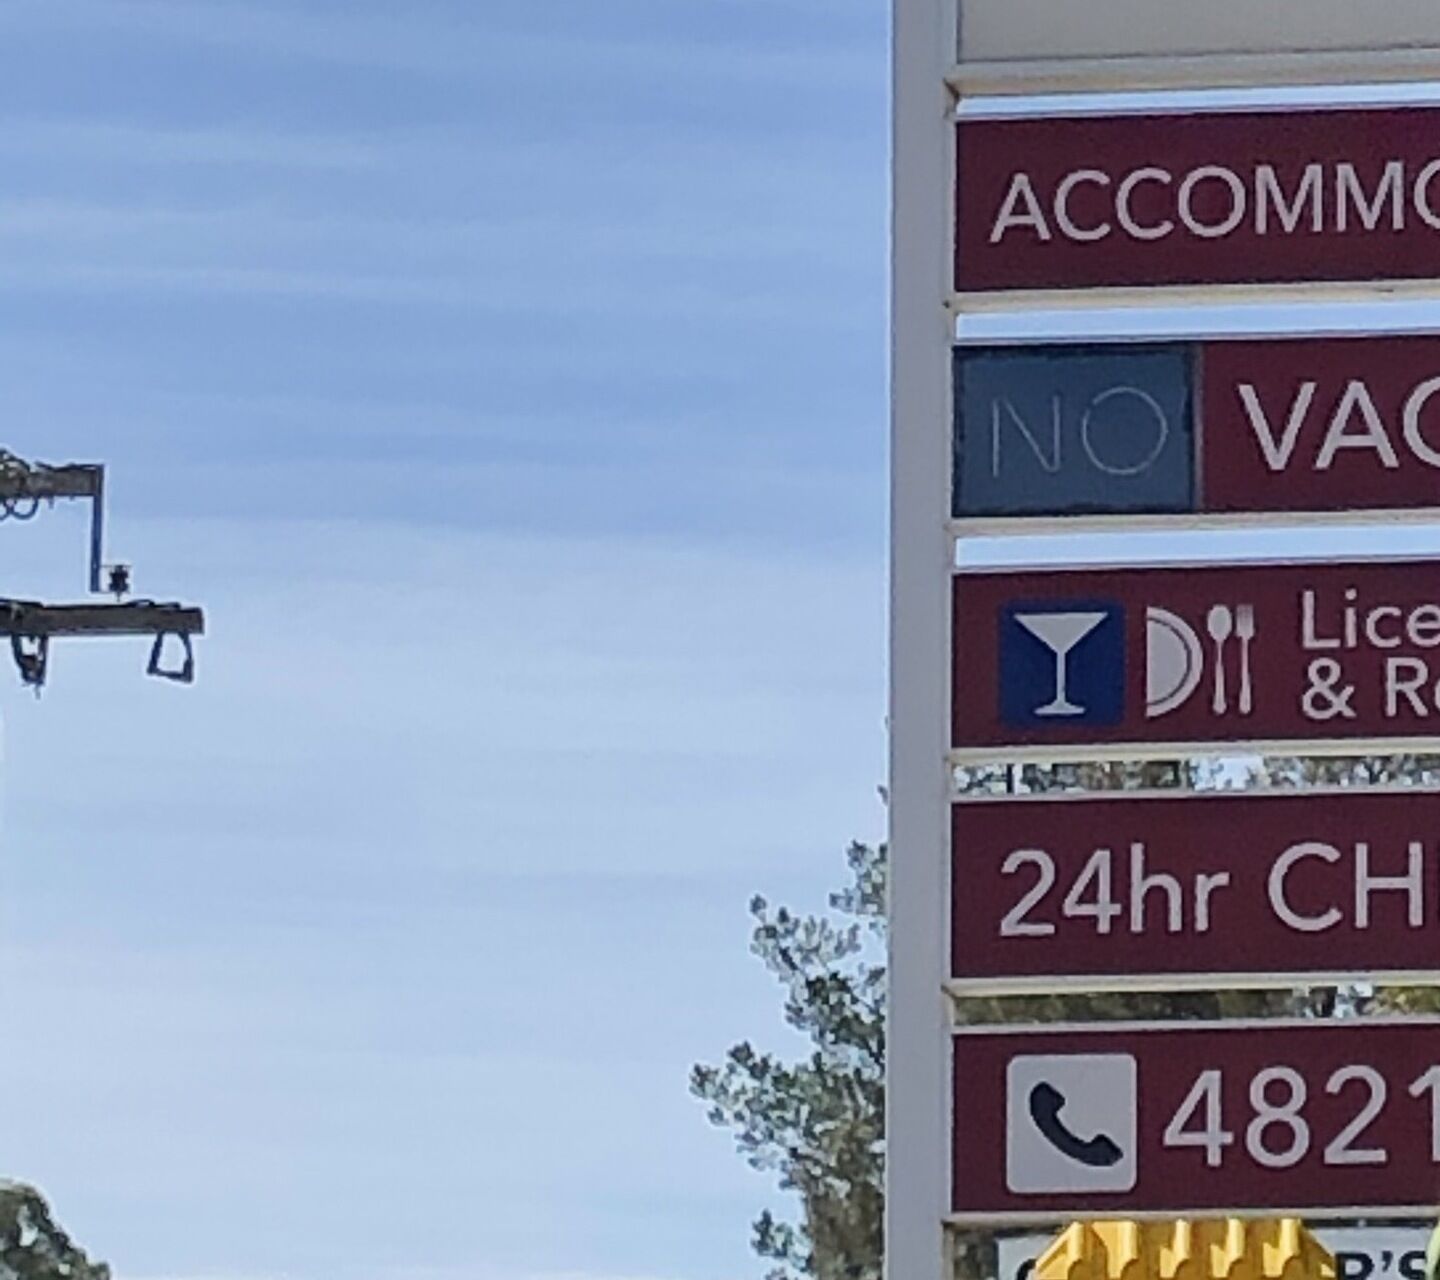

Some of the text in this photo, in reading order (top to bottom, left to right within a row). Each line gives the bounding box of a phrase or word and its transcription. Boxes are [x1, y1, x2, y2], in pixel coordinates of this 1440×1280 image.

[991, 385, 1169, 478] NO
[1301, 657, 1356, 720] &
[999, 841, 1231, 937] 24hr
